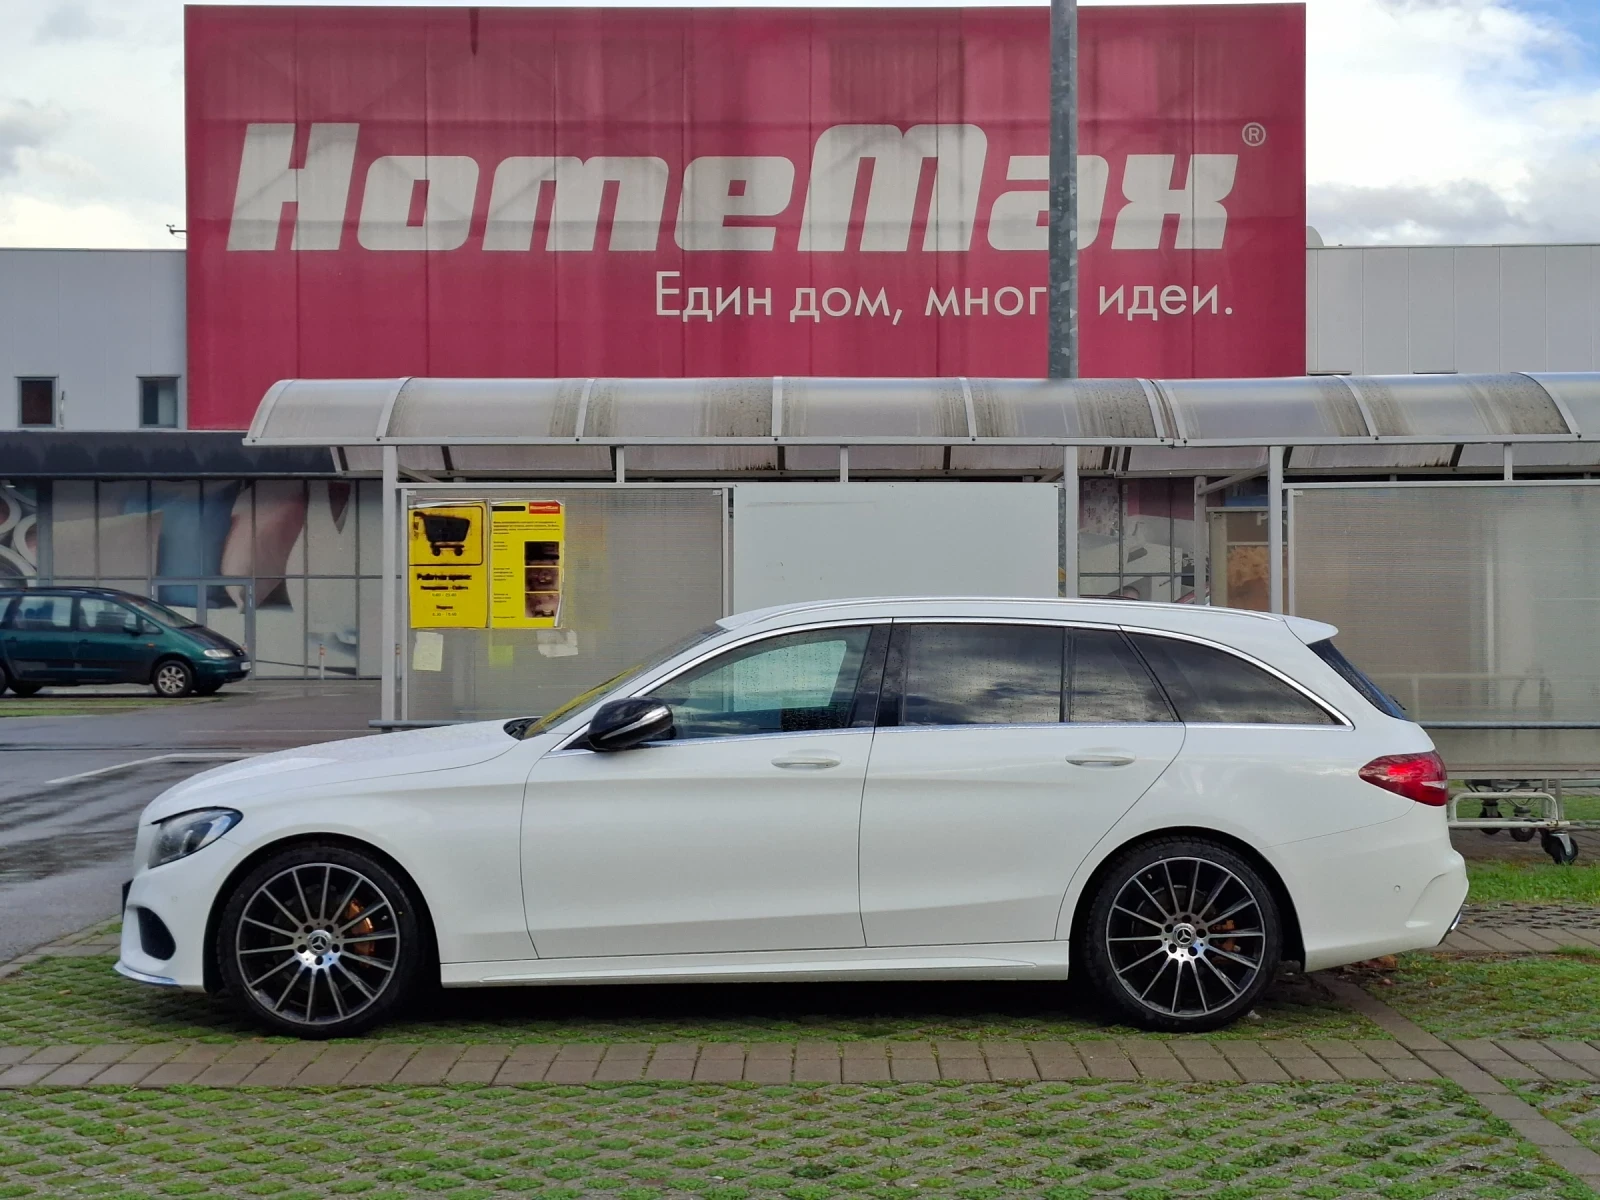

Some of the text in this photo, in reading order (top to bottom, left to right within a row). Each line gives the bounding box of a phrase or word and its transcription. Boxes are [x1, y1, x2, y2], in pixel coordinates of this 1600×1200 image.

[226, 122, 1238, 252] HomeMax
[656, 270, 1234, 325] Един дом, мног идеи.
